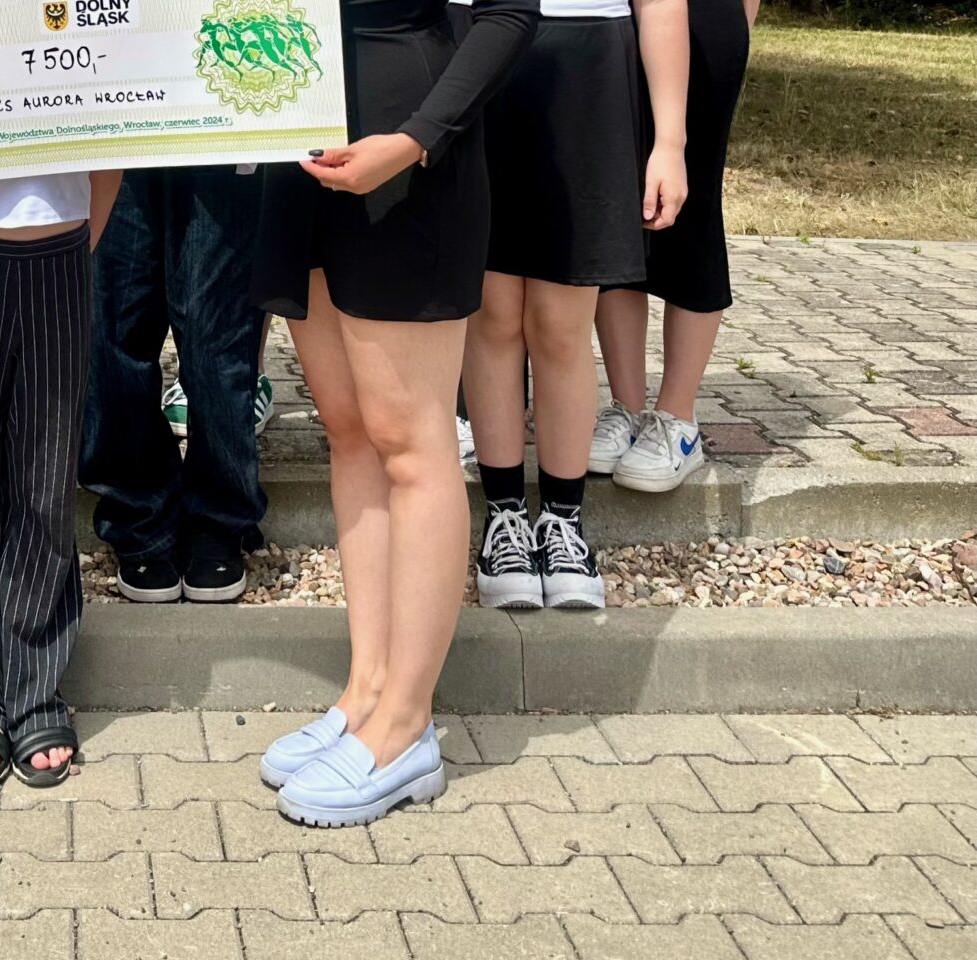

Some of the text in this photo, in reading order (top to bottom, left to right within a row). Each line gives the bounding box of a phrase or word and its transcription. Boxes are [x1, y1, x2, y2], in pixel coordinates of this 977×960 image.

[76, 10, 130, 27] ŚLĄSK
[23, 94, 84, 110] AURORA
[95, 89, 166, 104] WROCŁAW
[164, 118, 201, 127] czerwiec
[202, 116, 223, 125] 2024
